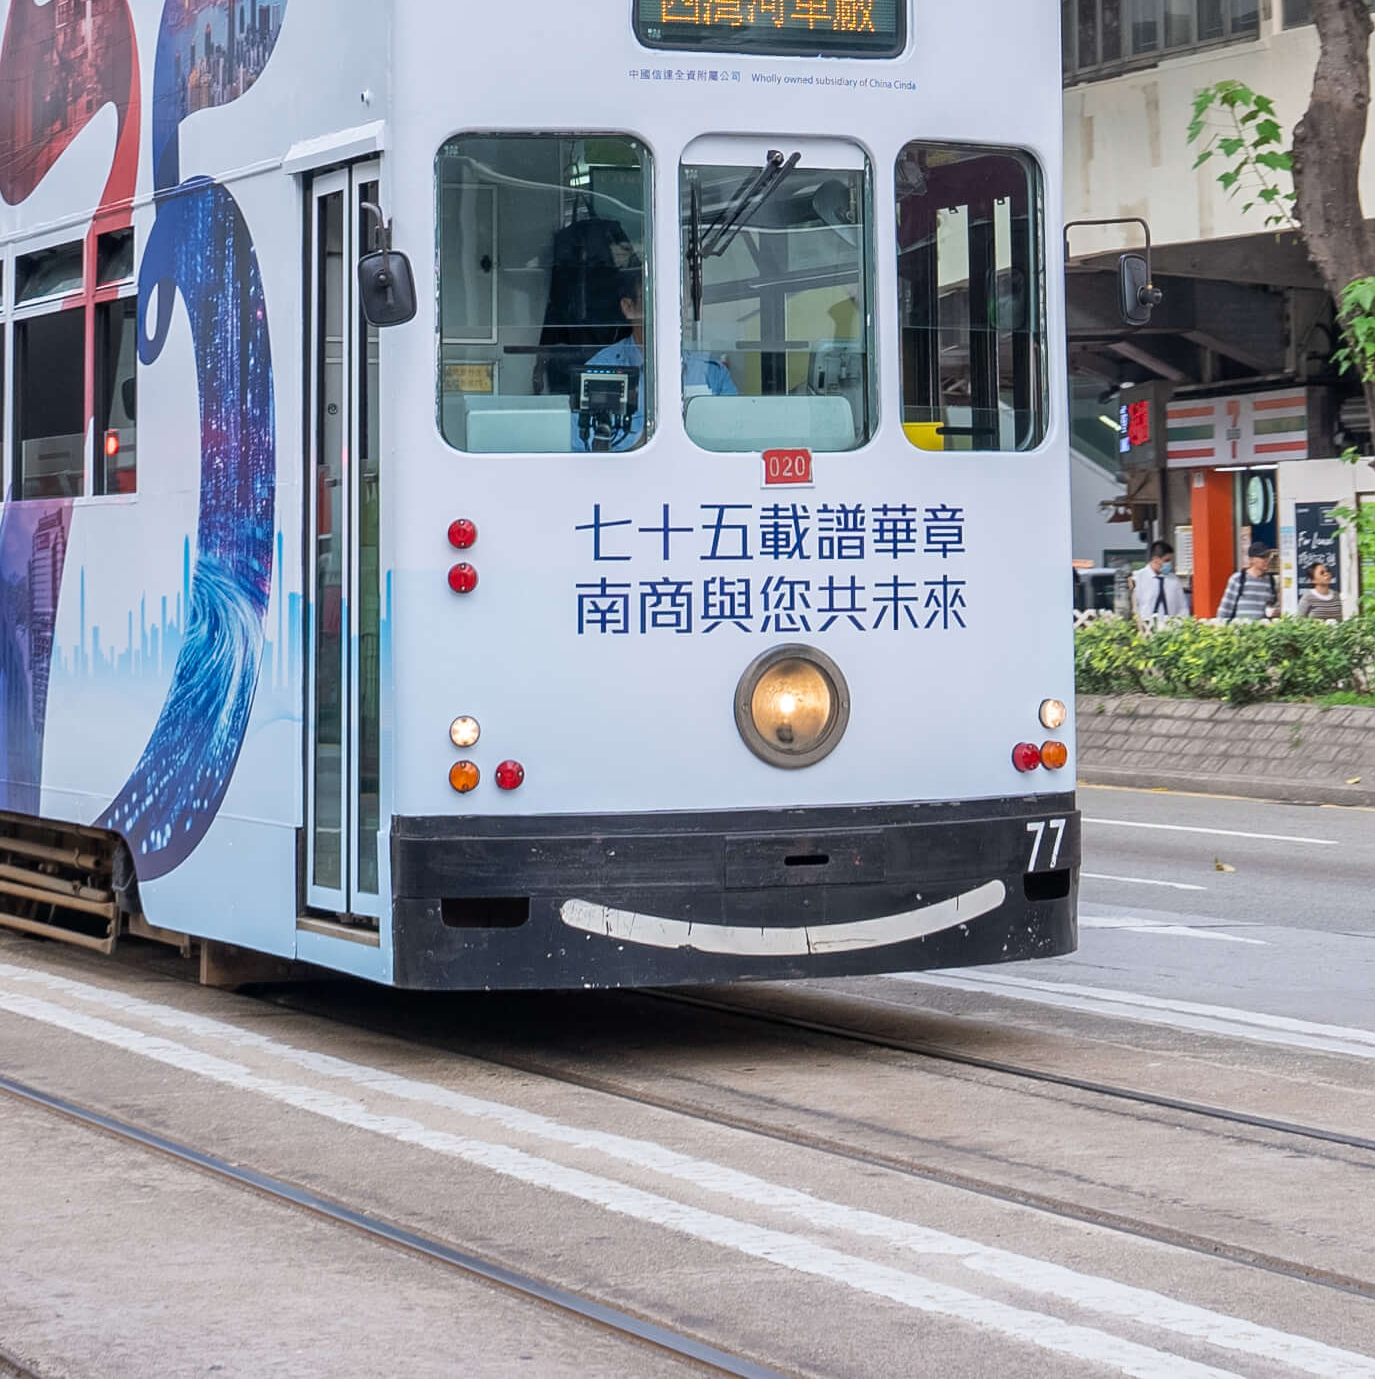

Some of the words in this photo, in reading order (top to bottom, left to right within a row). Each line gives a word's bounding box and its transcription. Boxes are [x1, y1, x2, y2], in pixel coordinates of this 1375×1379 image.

[751, 73, 781, 85] Wholly
[783, 76, 814, 85] owned
[815, 77, 858, 89] subsidiary
[859, 78, 868, 88] of
[869, 79, 892, 89] China
[893, 79, 917, 91] Cinda
[768, 455, 806, 479] 020
[574, 502, 966, 562] 七十五載譜華章
[575, 575, 967, 635] 南商與您共未來
[1025, 817, 1066, 872] 77
